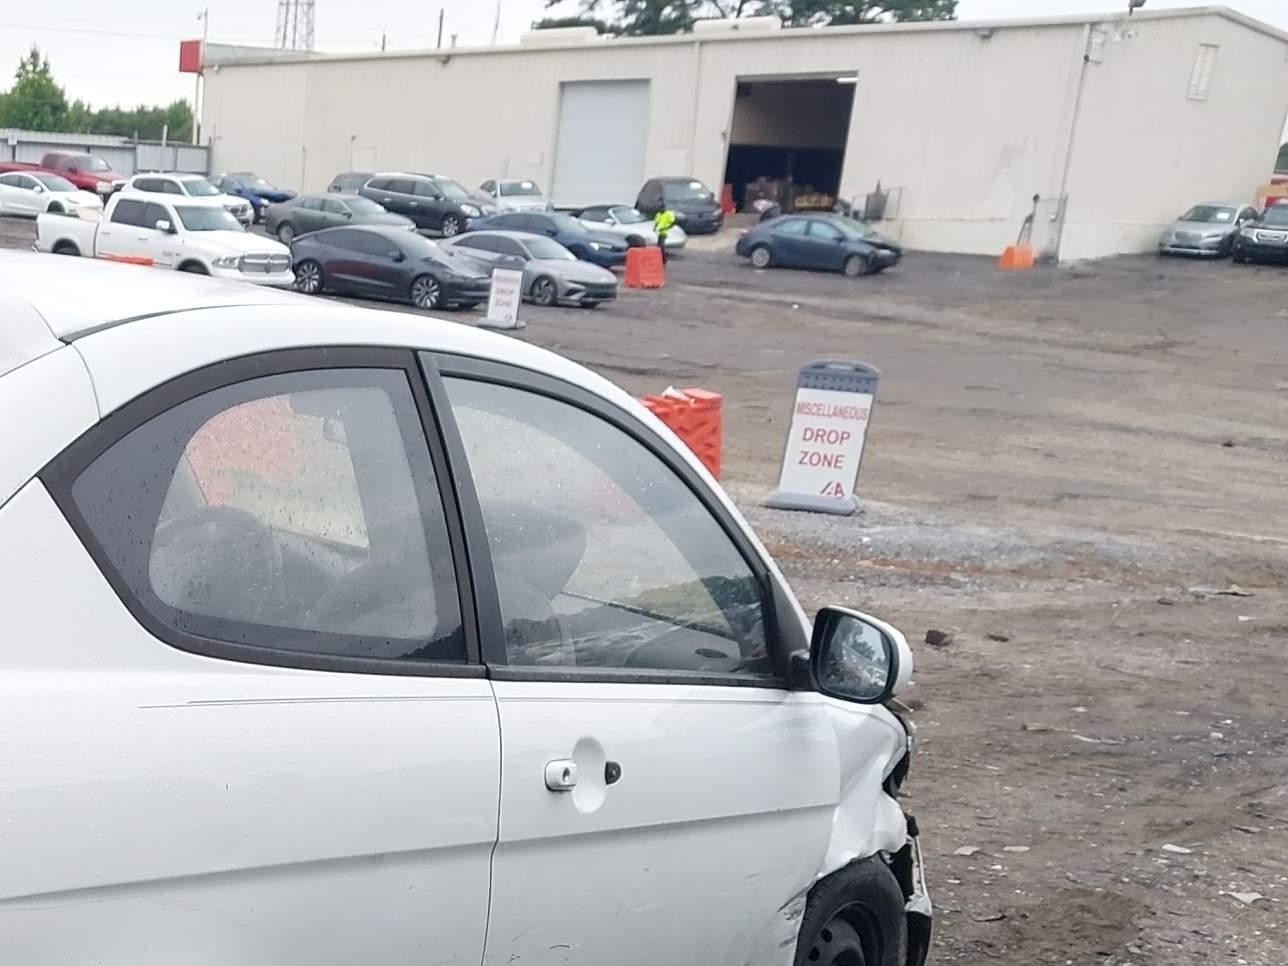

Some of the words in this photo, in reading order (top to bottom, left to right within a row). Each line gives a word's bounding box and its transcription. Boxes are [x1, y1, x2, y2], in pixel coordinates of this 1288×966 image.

[796, 402, 869, 421] MISCELLANEOUS
[802, 427, 851, 445] DROP
[798, 450, 845, 469] ZONE
